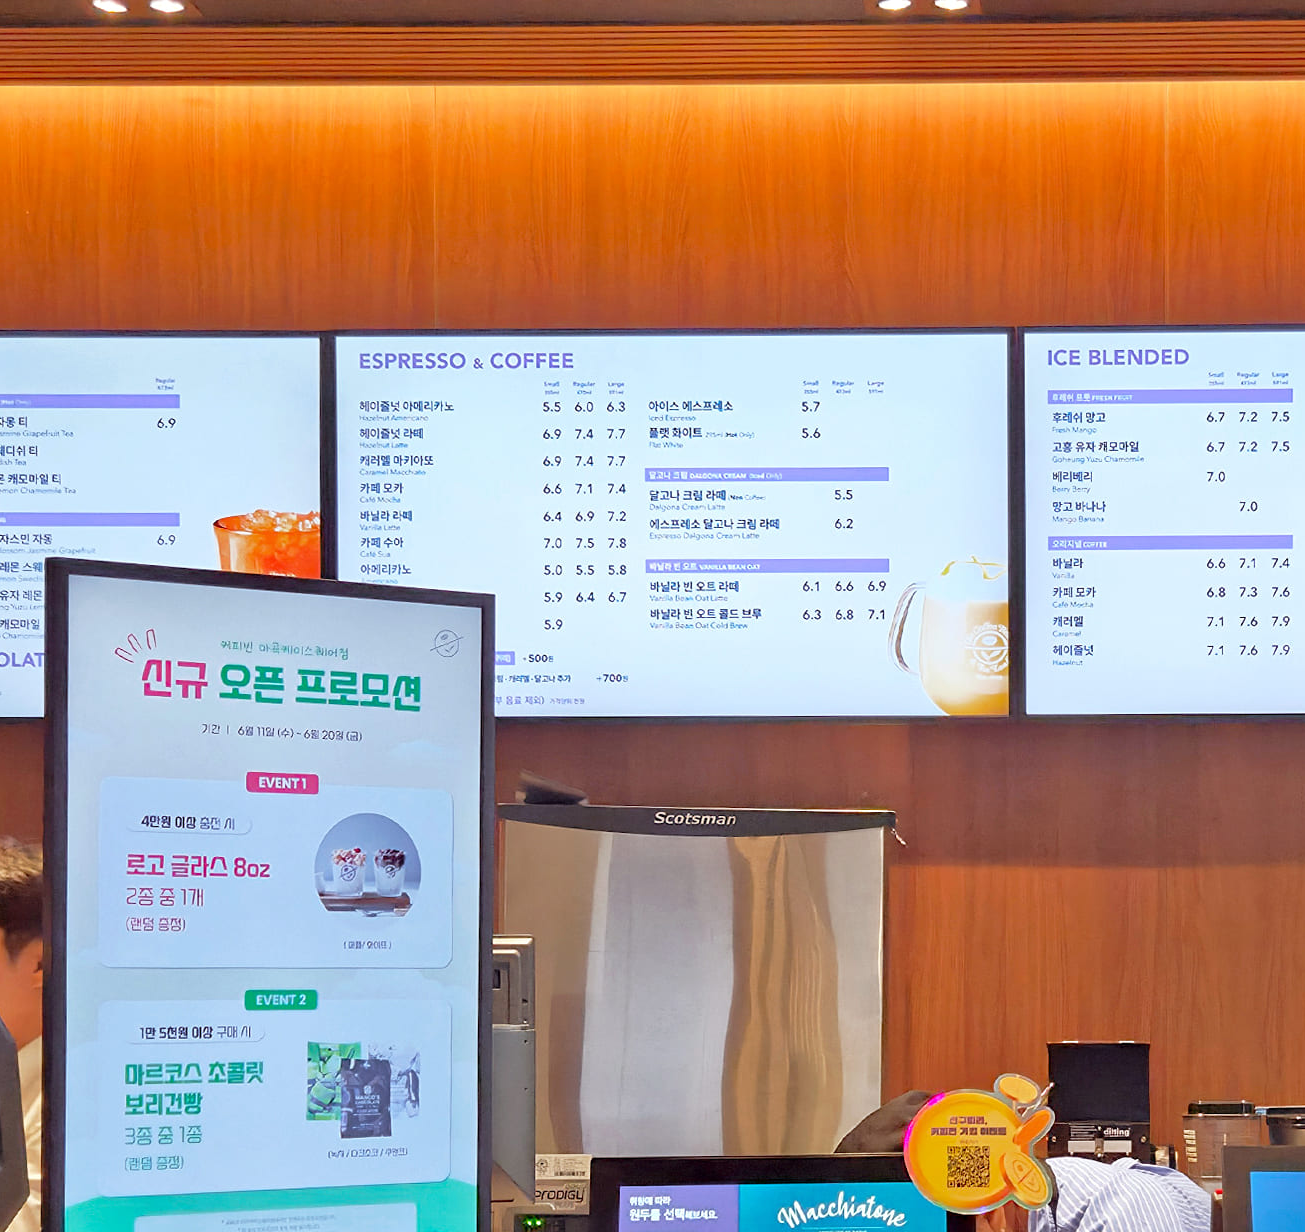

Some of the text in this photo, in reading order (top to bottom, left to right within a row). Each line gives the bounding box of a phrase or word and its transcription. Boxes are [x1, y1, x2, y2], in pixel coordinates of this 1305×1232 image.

[359, 353, 574, 369] ESPRESSO & COFFEE
[1048, 349, 1189, 366] ICE BLENDED
[359, 401, 454, 412] 헤이즐넛 아메리카노
[543, 402, 625, 412] 5.5 6.0 6.3
[649, 401, 733, 412] 아이스 에스프레소
[801, 402, 820, 412] 5.7
[18, 416, 27, 428] 티
[157, 418, 176, 428] 6.9
[1053, 412, 1106, 423] 후레쉬 망고
[1206, 412, 1289, 422] 6.7 7.2 7.5
[360, 564, 411, 575] 아메리카노
[544, 565, 627, 575] 5.0 5.5 5.8
[142, 659, 421, 712] 신규 오픈 프로모션
[201, 723, 221, 735] 기간
[259, 777, 307, 789] EVENT 1
[654, 812, 736, 825] Scotsman
[127, 854, 270, 878] 로고 글라스 8oz
[256, 994, 306, 1006] EVENT 2
[125, 1061, 264, 1085] 마르코스 초콜릿
[125, 1092, 203, 1115] 보리건빵
[777, 1191, 907, 1228] Macchiatone
